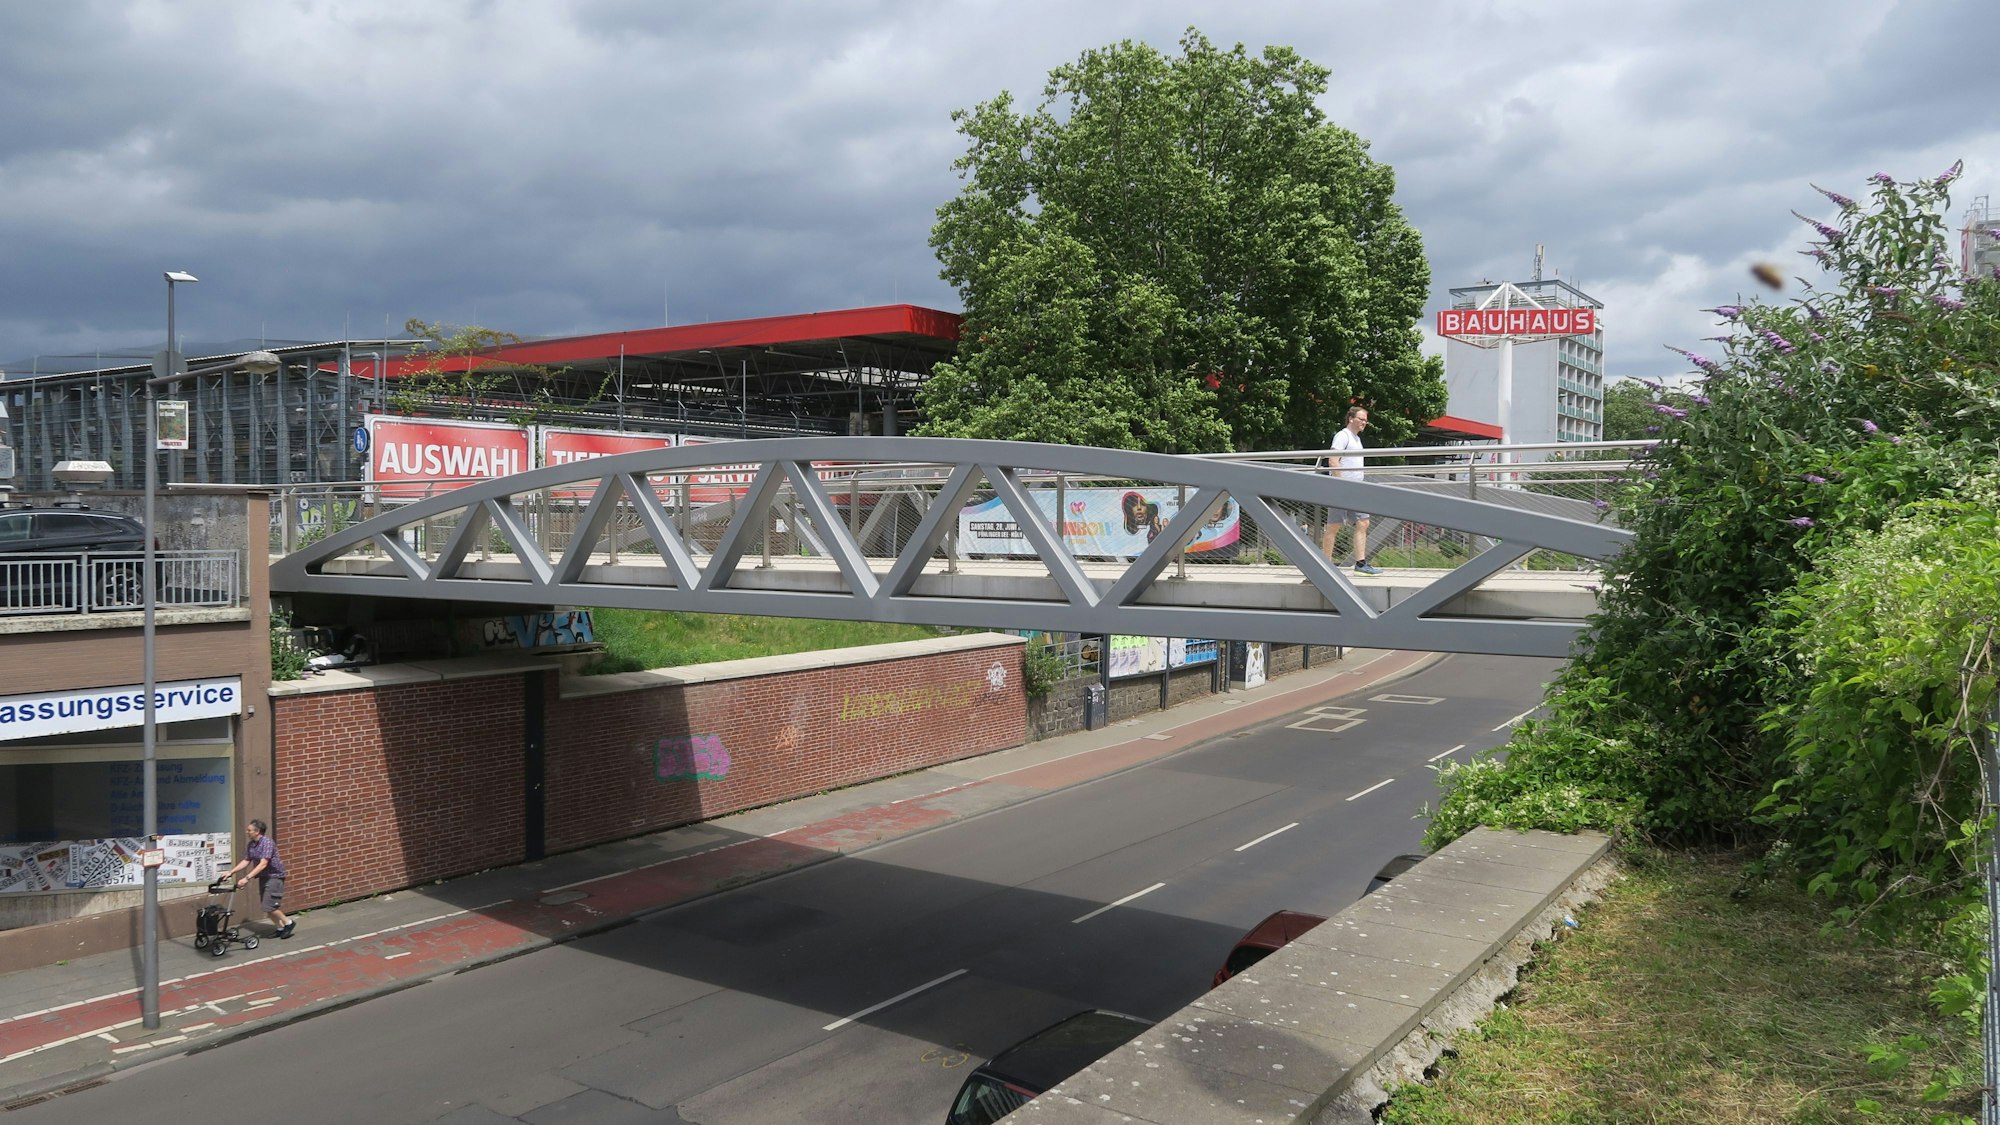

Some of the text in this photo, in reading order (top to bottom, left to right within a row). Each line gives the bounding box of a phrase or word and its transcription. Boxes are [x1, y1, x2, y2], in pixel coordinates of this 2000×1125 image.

[1445, 312, 1590, 332] BAUHAUS
[379, 442, 520, 477] AUSWAHL
[0, 684, 234, 724] assungsservice
[174, 773, 225, 784] Abmeldung
